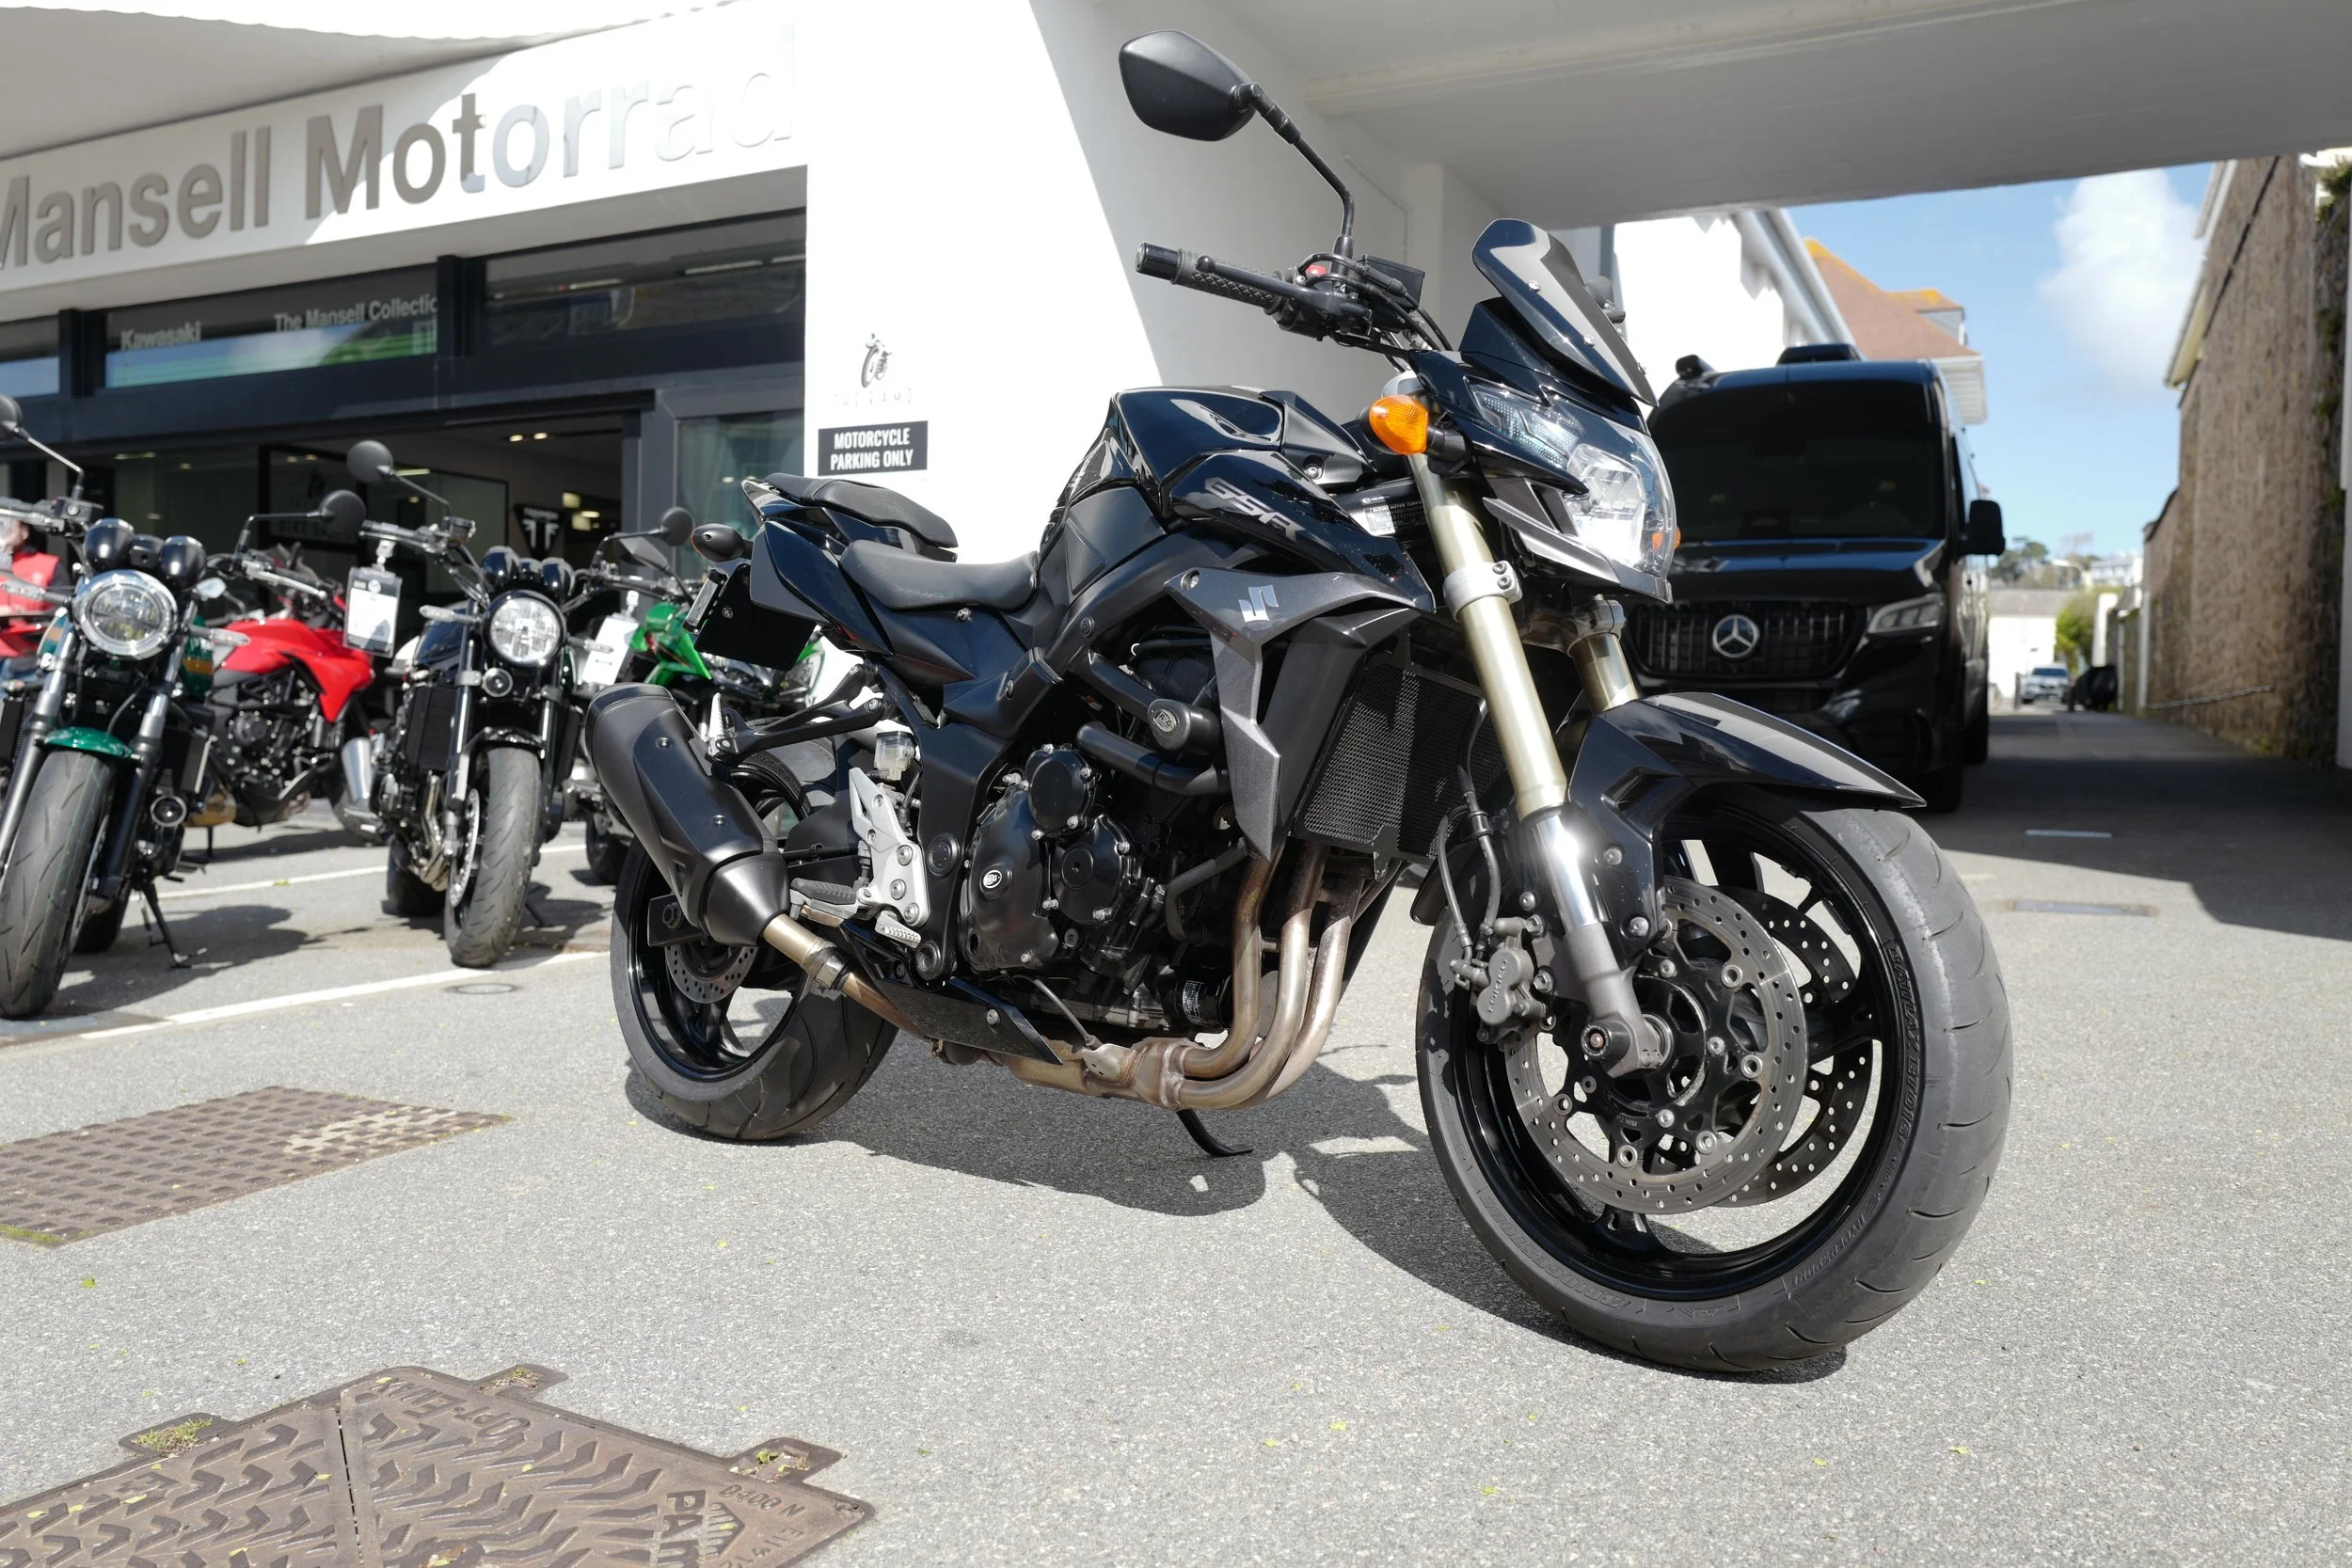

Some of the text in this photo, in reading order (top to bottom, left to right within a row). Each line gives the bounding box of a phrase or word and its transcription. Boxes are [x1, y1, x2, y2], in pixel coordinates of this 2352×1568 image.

[306, 19, 795, 220] Motorrad
[274, 312, 303, 332] The
[306, 303, 365, 328] Mansell
[120, 321, 201, 350] Kawasaki
[834, 428, 911, 450] MOTORCYCLE
[830, 449, 914, 470] PARKING ONLY
[1205, 477, 1306, 543] GSR
[1478, 1195, 1630, 1309] BRIDGESTONE
